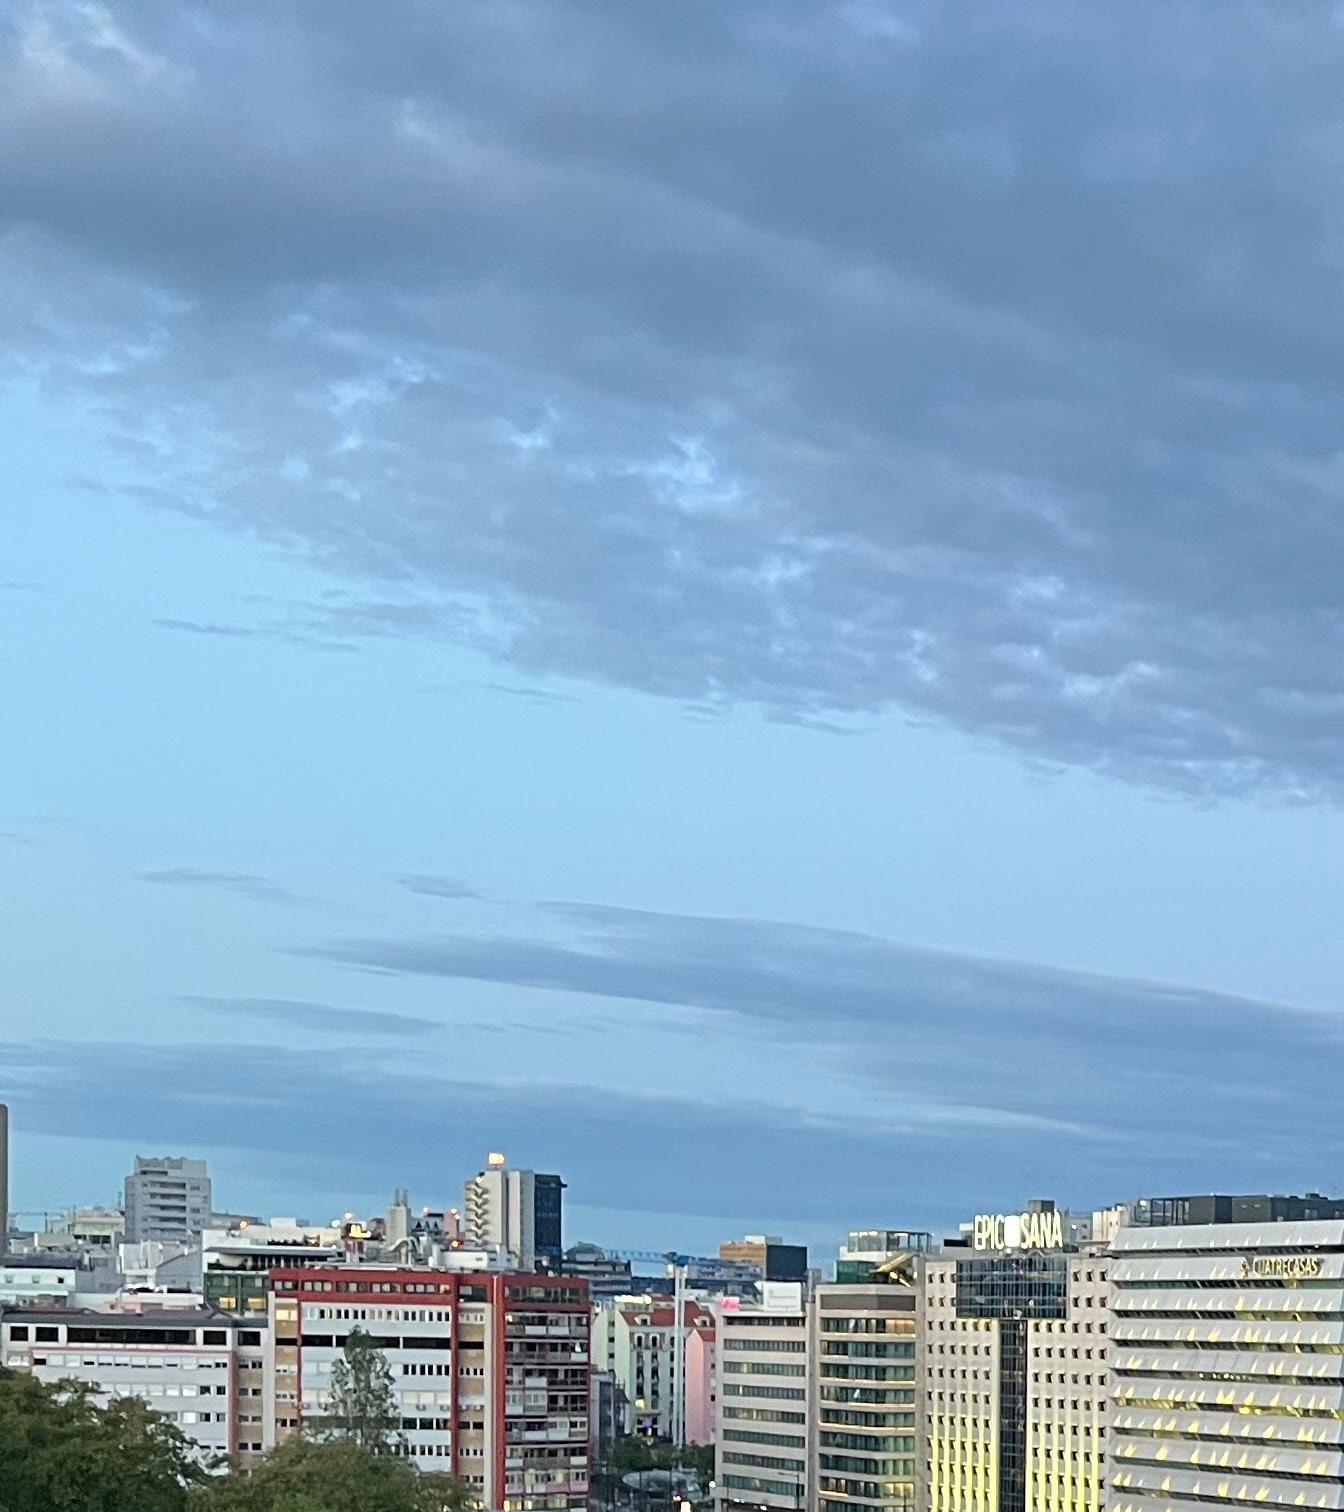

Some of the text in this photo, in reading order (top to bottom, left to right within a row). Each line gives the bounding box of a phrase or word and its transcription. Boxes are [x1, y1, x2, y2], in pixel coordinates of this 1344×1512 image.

[974, 1211, 1063, 1251] EPIC SANA
[1253, 1256, 1318, 1276] CUATRECASAS
